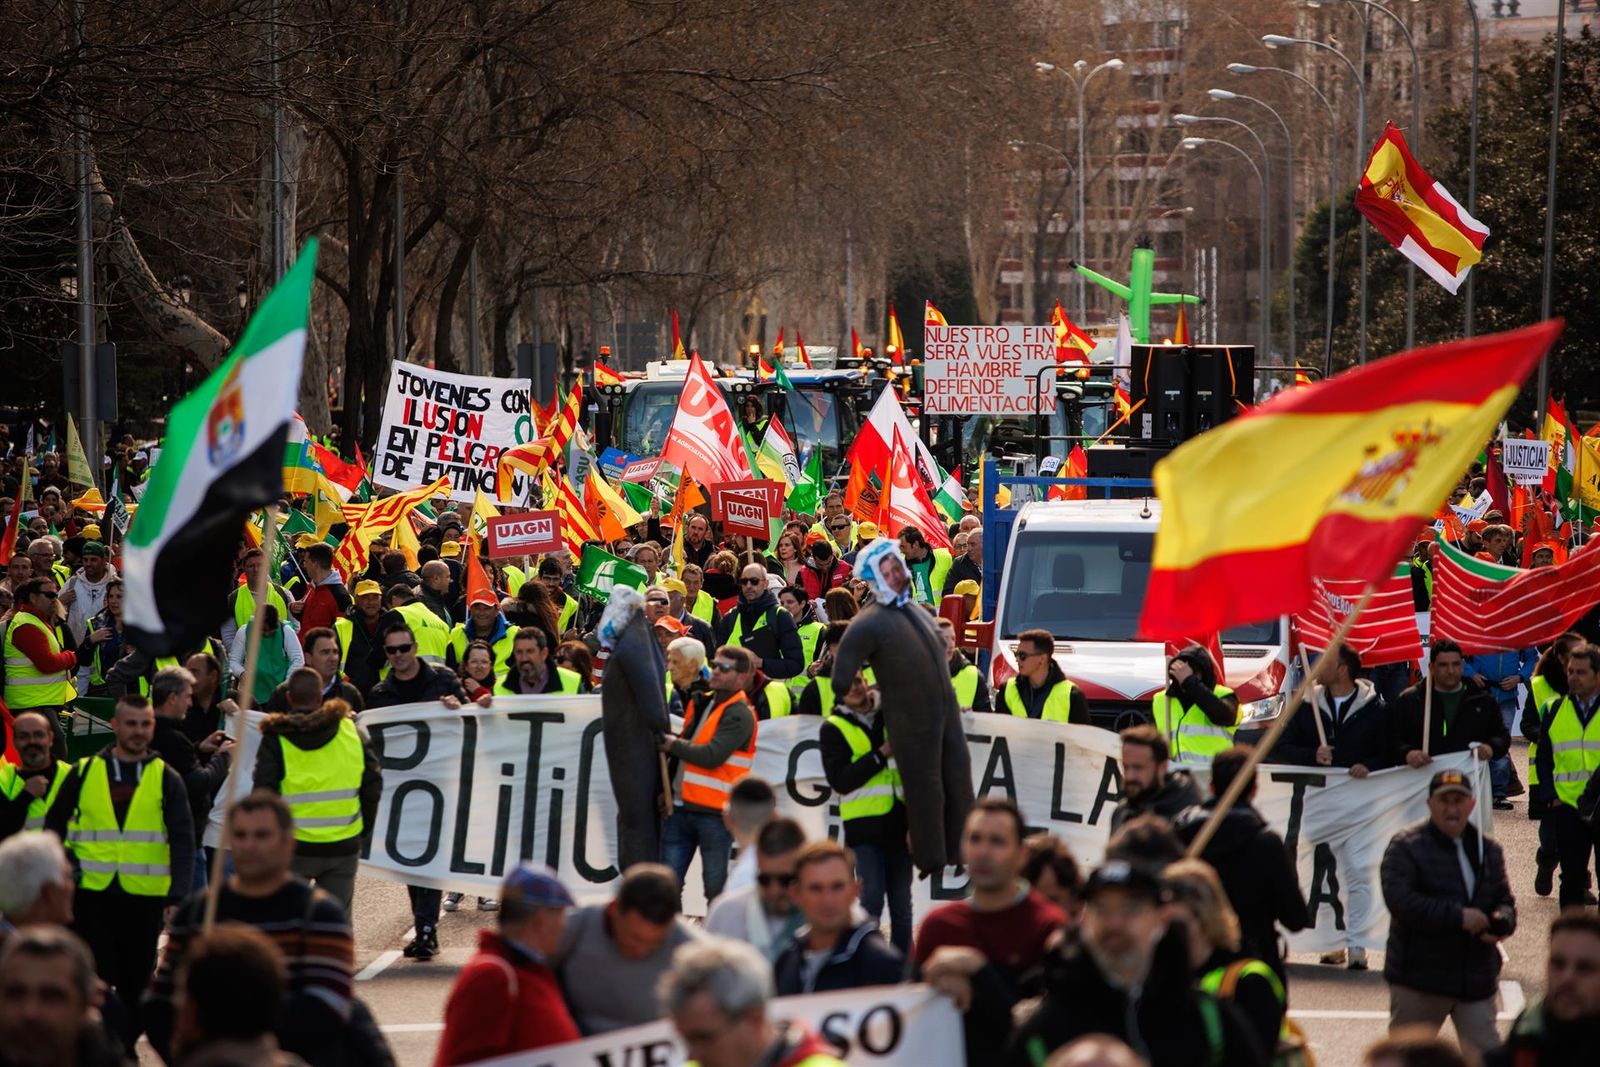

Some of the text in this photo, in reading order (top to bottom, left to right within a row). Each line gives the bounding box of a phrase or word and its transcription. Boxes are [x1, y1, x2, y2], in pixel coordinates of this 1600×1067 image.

[926, 327, 1055, 343] NUESTRO FIN
[926, 344, 1056, 360] SERA VUESTRA
[947, 362, 1022, 377] HAMBRE
[398, 369, 530, 414] JOVENES CON
[926, 379, 1051, 394] DEFIENDE TU
[925, 396, 1056, 412] ALIMENTACION
[387, 426, 418, 454] EN
[381, 452, 524, 496] DE EXTINCIN
[628, 462, 657, 474] UAGN
[728, 502, 763, 521] UAGN
[498, 520, 550, 538] UAGN
